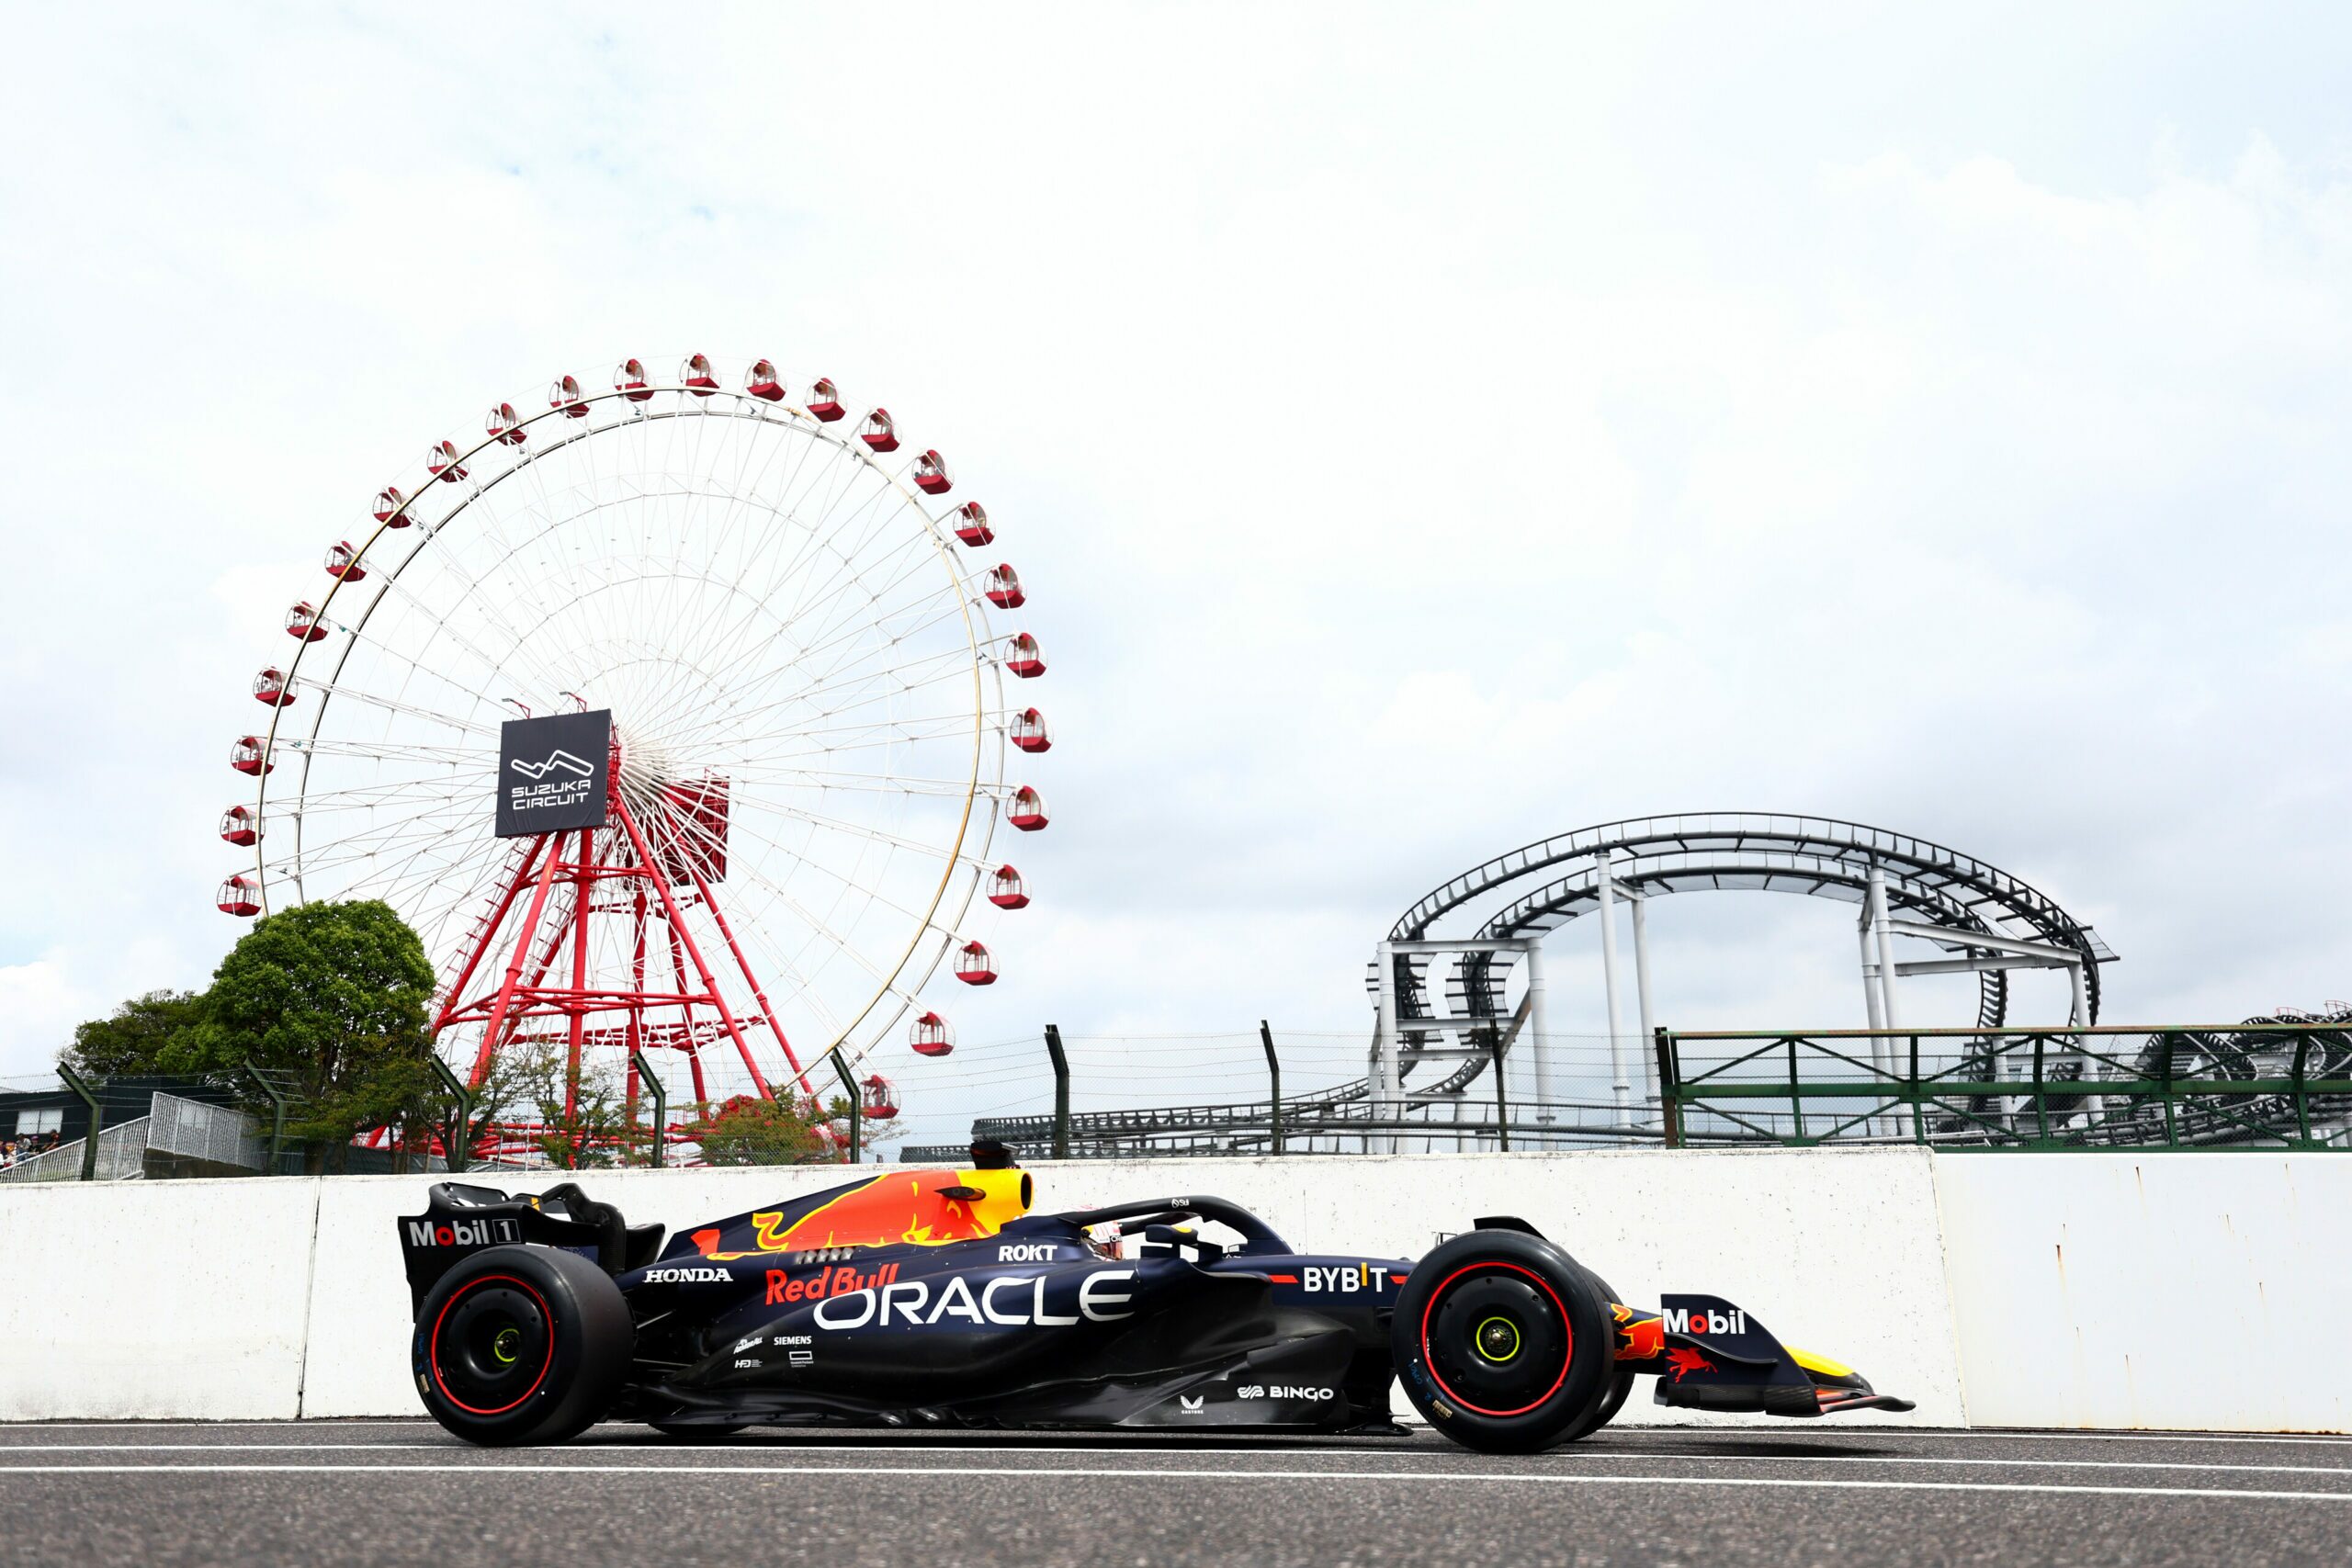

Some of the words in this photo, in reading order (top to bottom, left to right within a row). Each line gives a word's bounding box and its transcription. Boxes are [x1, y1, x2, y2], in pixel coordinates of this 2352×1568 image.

[511, 779, 592, 798] SUZUKA
[512, 792, 589, 810] CIRCUIT
[409, 1219, 490, 1247] Mobil
[500, 1221, 512, 1241] 1
[998, 1244, 1058, 1262] ROKT
[643, 1268, 734, 1283] HONDA
[764, 1266, 831, 1306] Red
[830, 1263, 901, 1297] Bull
[1304, 1261, 1388, 1292] BYBIT
[813, 1269, 1136, 1331] ORACLE
[1662, 1308, 1746, 1335] Mobil
[774, 1335, 812, 1346] SIEMENS
[1269, 1385, 1334, 1403] BINGO
